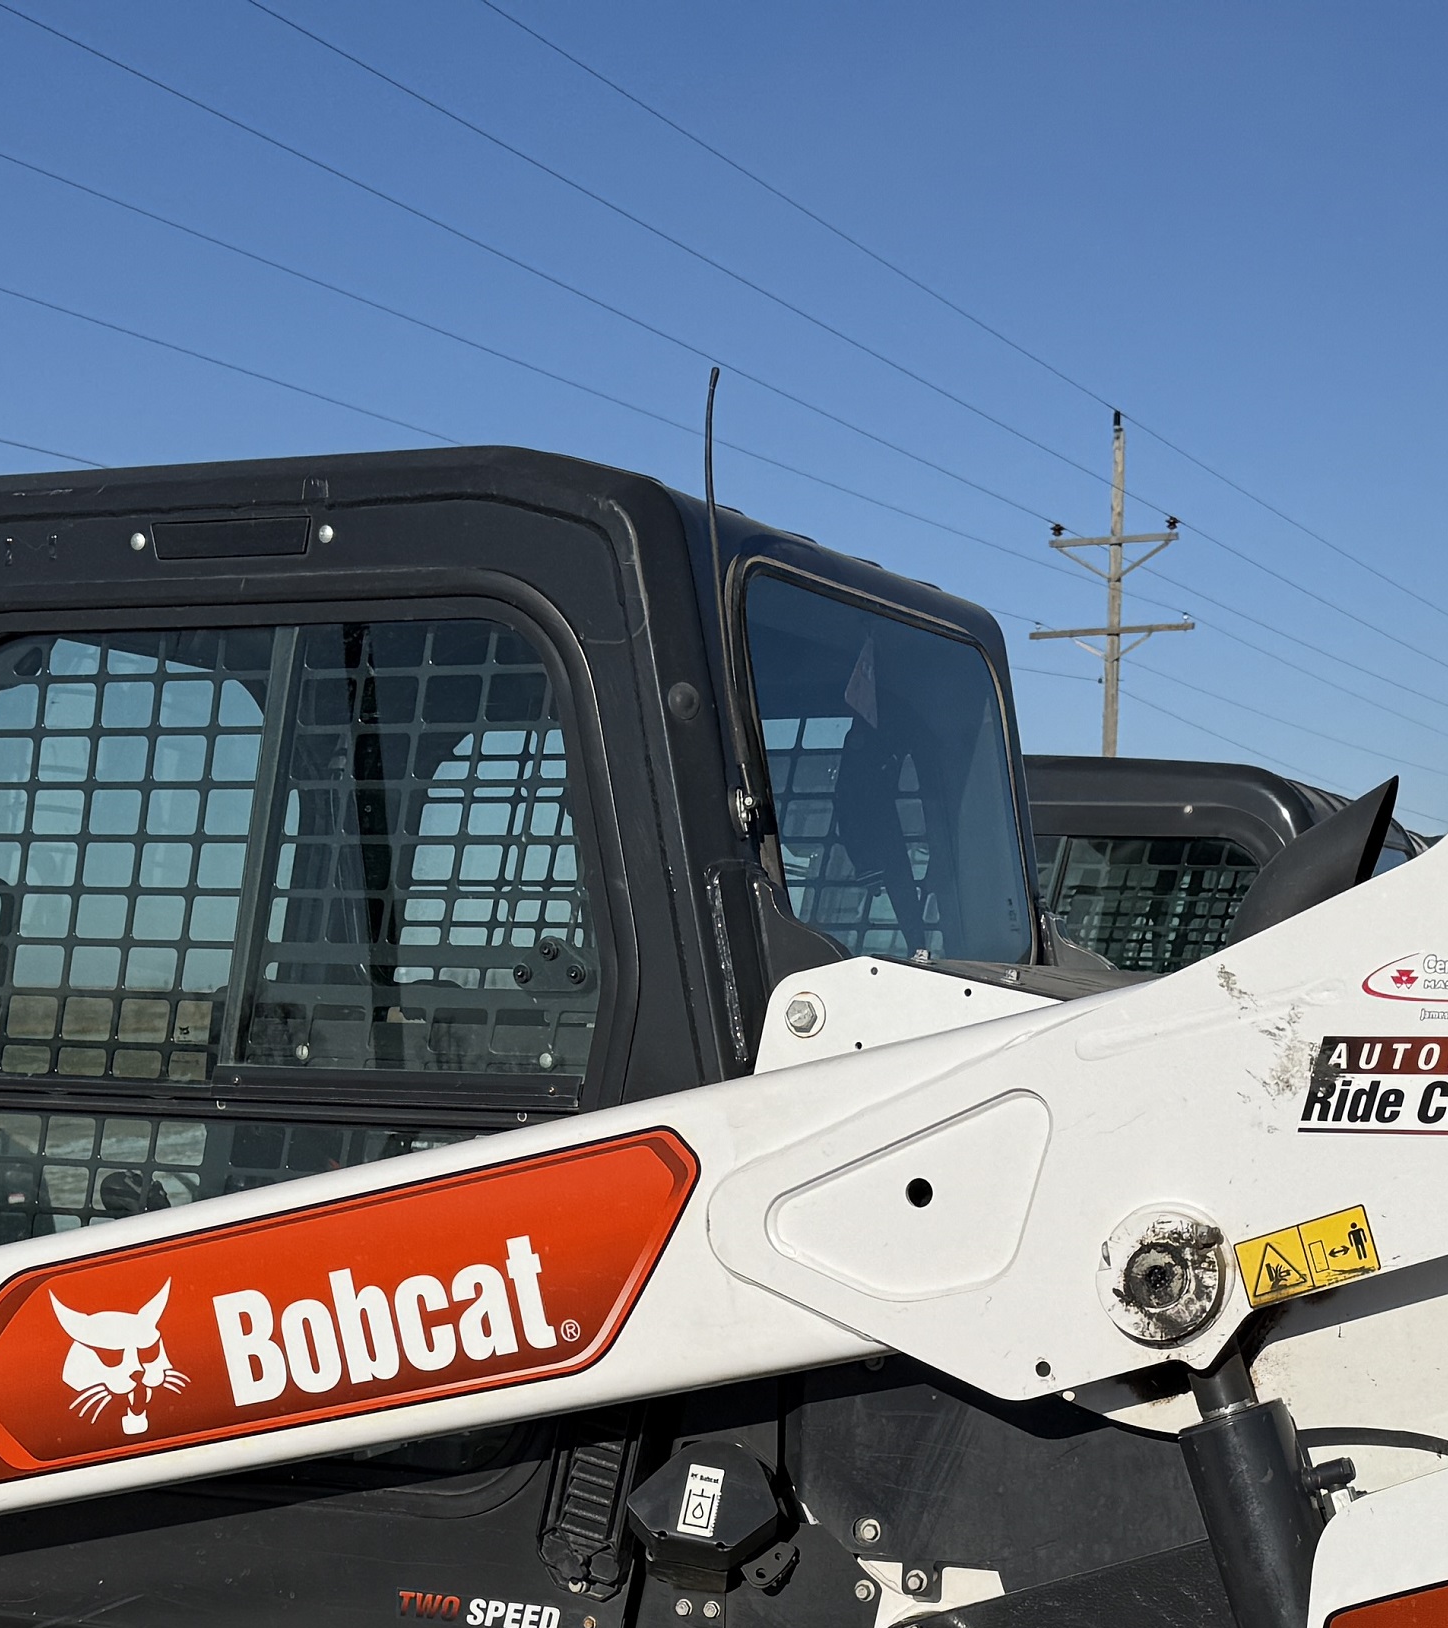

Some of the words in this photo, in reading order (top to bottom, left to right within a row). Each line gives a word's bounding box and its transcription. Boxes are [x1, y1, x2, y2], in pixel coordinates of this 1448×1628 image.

[1300, 1080, 1405, 1124] Ride
[212, 1234, 559, 1408] Bobcat
[399, 1590, 461, 1622] TWO
